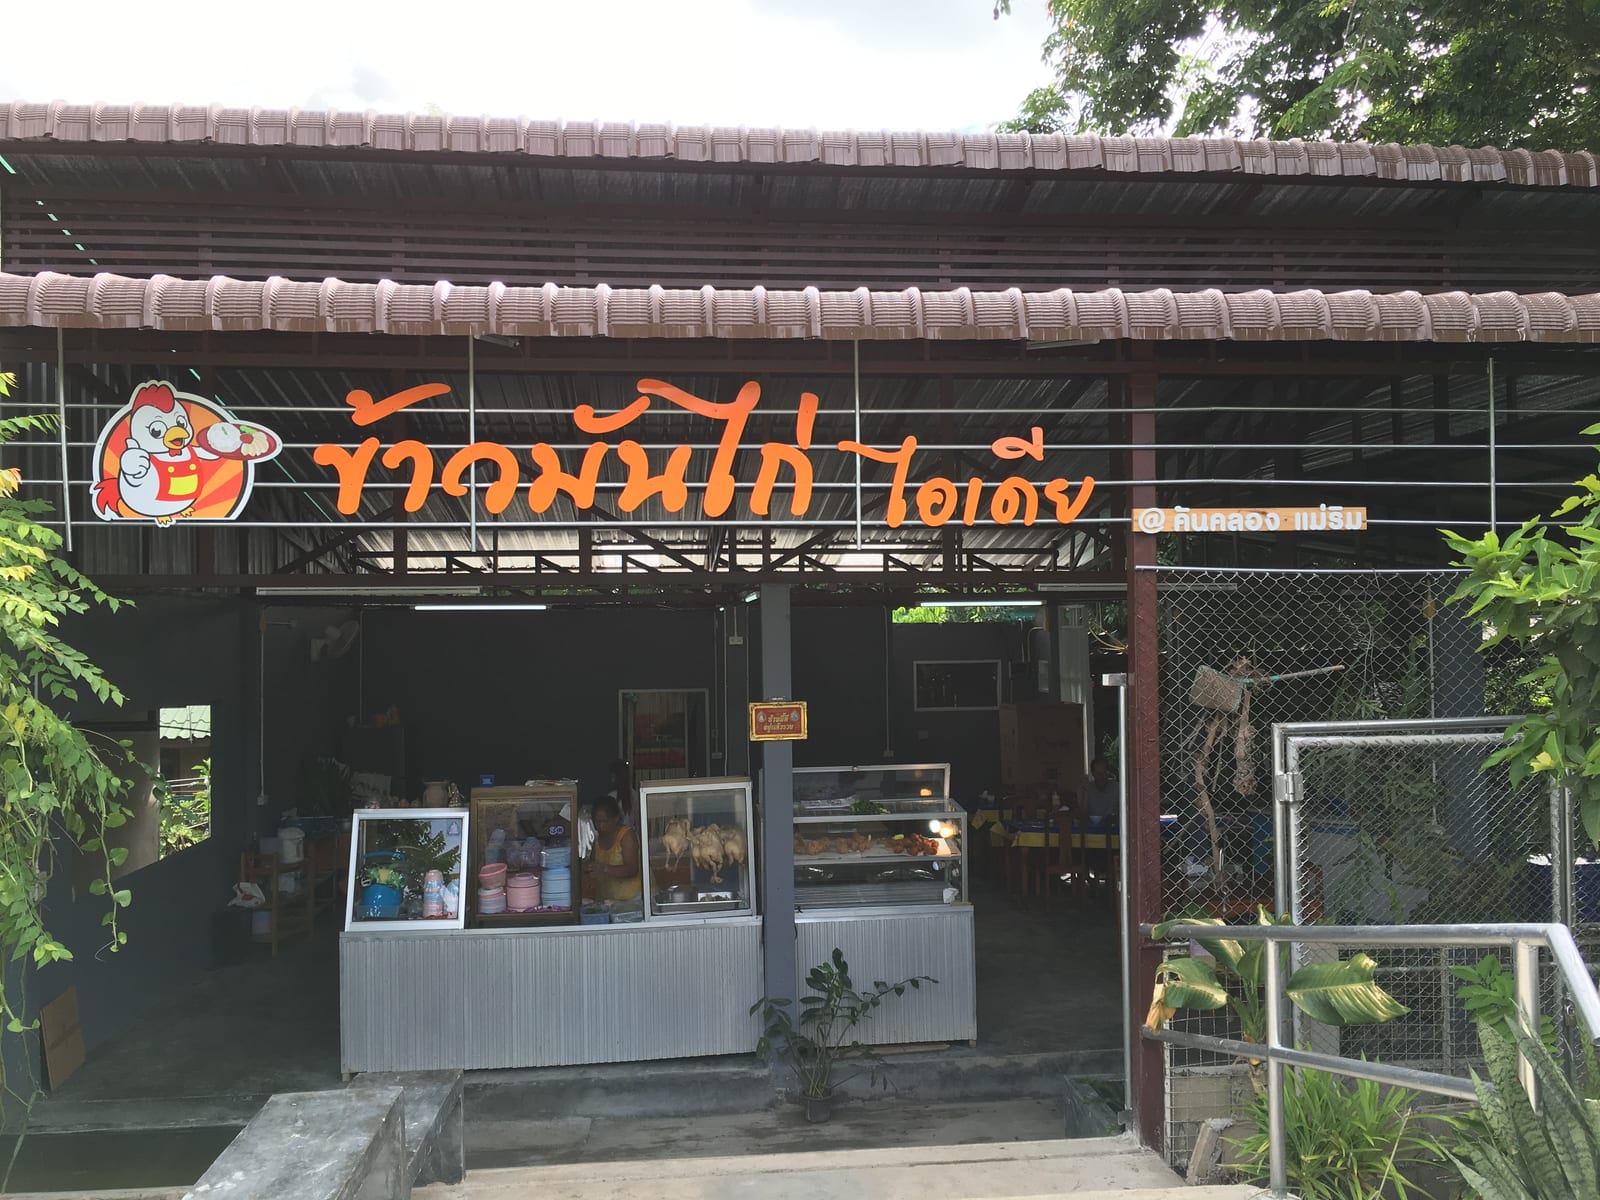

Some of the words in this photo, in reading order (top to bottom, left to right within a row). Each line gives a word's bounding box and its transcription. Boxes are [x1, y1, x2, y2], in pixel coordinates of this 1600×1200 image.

[313, 381, 818, 517] ข้าวมันไก่
[837, 426, 1095, 528] ไอเดีย
[1138, 507, 1166, 534] @
[1173, 505, 1281, 532] คันคลอง
[1294, 503, 1363, 531] แม่ริม
